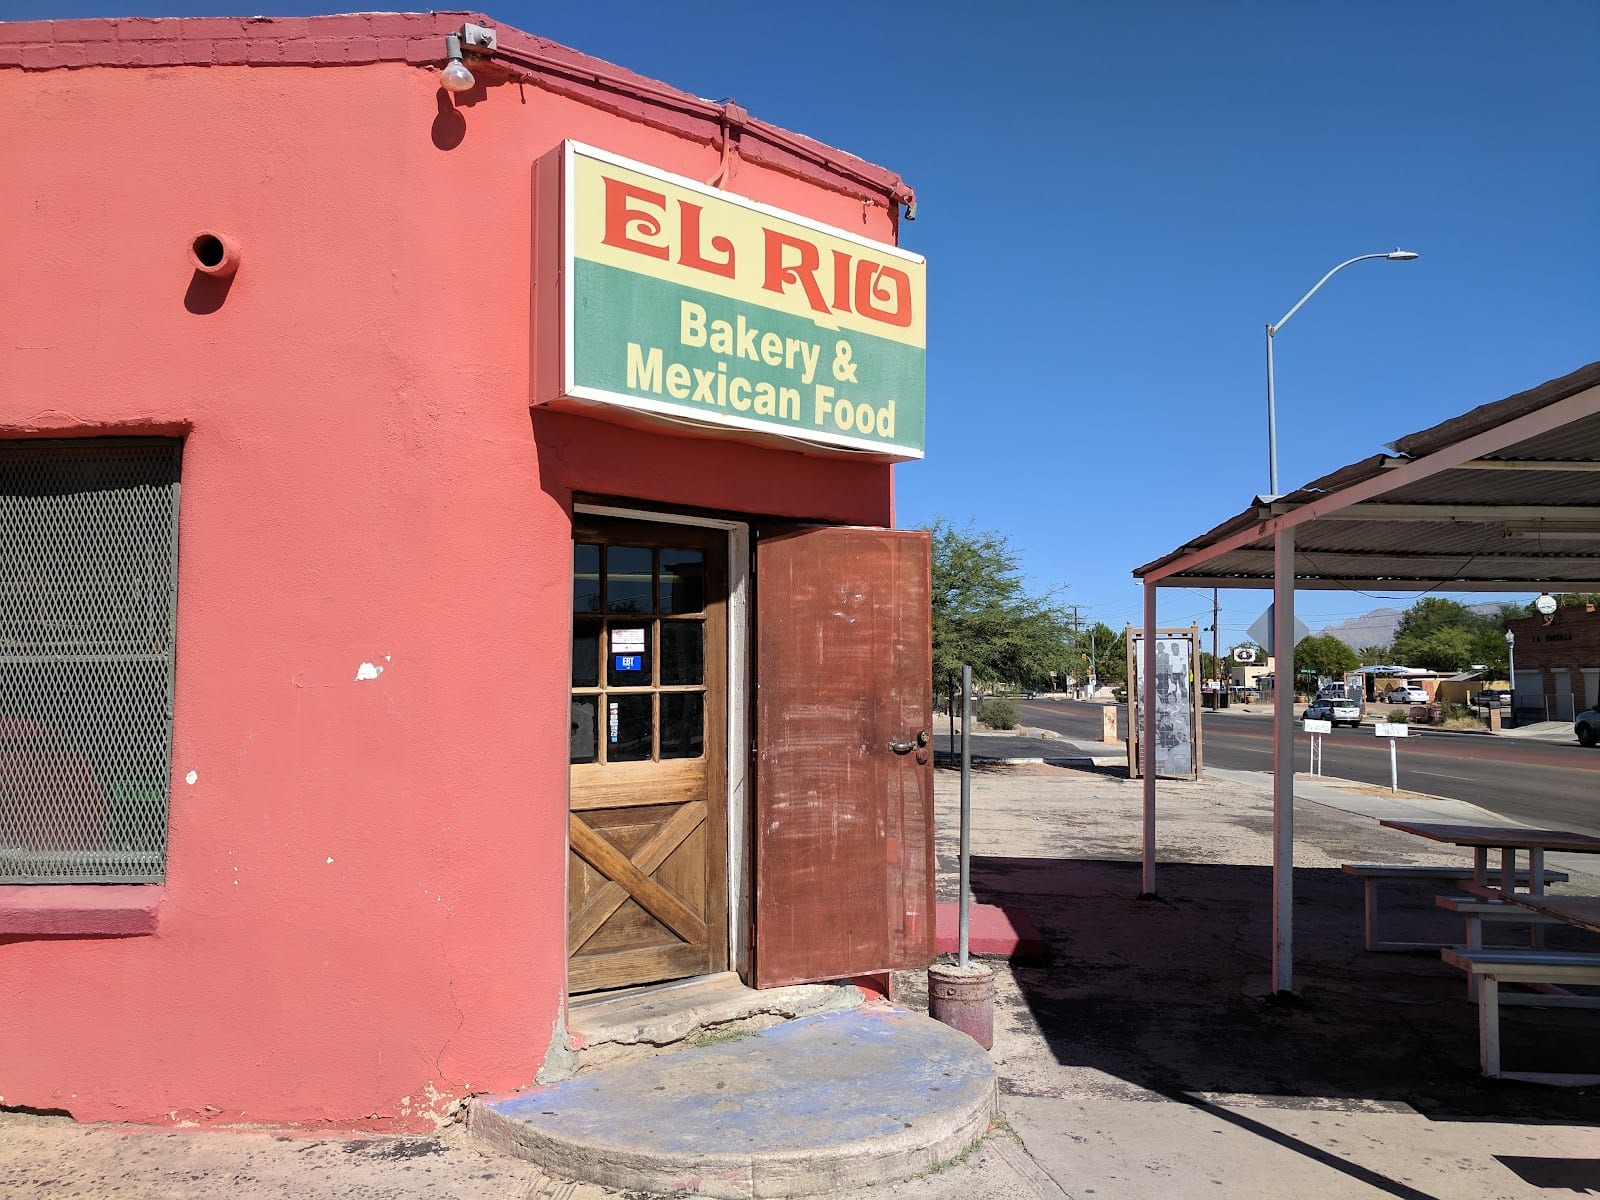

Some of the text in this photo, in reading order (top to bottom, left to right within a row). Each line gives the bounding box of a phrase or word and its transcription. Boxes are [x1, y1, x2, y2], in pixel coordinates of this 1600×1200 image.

[601, 176, 912, 328] EL RIO
[680, 299, 859, 385] Bakery &
[626, 342, 897, 439] Mexican Food
[622, 656, 635, 667] EBT
